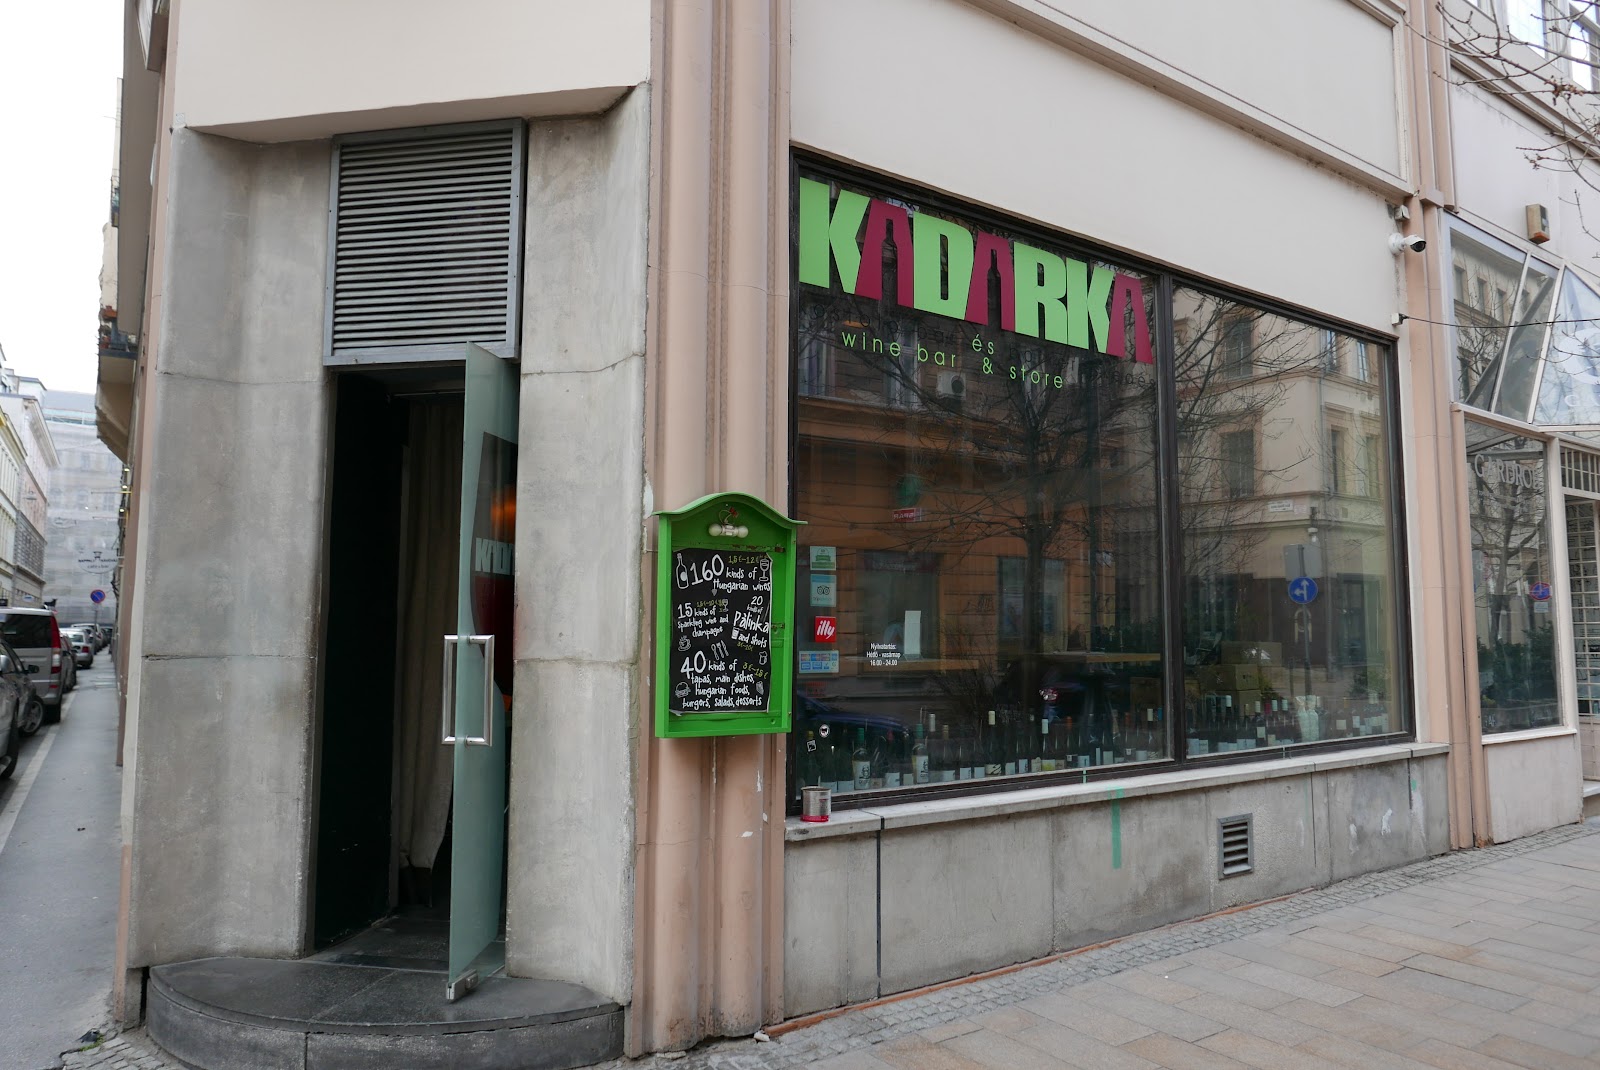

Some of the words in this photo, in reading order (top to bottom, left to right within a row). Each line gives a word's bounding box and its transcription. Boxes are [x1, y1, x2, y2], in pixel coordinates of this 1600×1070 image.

[800, 177, 1153, 364] KADARKA
[972, 334, 996, 355] és
[842, 332, 901, 358] wine
[917, 344, 957, 368] bar
[983, 358, 994, 374] &
[1009, 366, 1063, 389] store
[689, 553, 725, 586] 160
[725, 567, 745, 580] kinds
[748, 566, 758, 580] of
[712, 578, 750, 594] Hungarian
[752, 581, 771, 592] wines
[750, 595, 764, 606] 20
[677, 602, 693, 620] 15
[694, 607, 709, 617] kinds
[709, 604, 717, 616] of
[719, 613, 729, 624] and
[692, 626, 724, 640] champagne
[816, 620, 835, 640] illy
[738, 632, 750, 644] and
[751, 632, 768, 649] shots
[680, 650, 707, 680] 40
[708, 659, 726, 672] kinds
[728, 658, 739, 672] of
[691, 672, 712, 689] tapas,
[715, 672, 731, 684] main
[733, 670, 756, 685] dishes,
[695, 682, 727, 699] hungarian
[730, 682, 750, 696] foods,
[682, 697, 711, 711] burgers,
[735, 695, 763, 707] desserts
